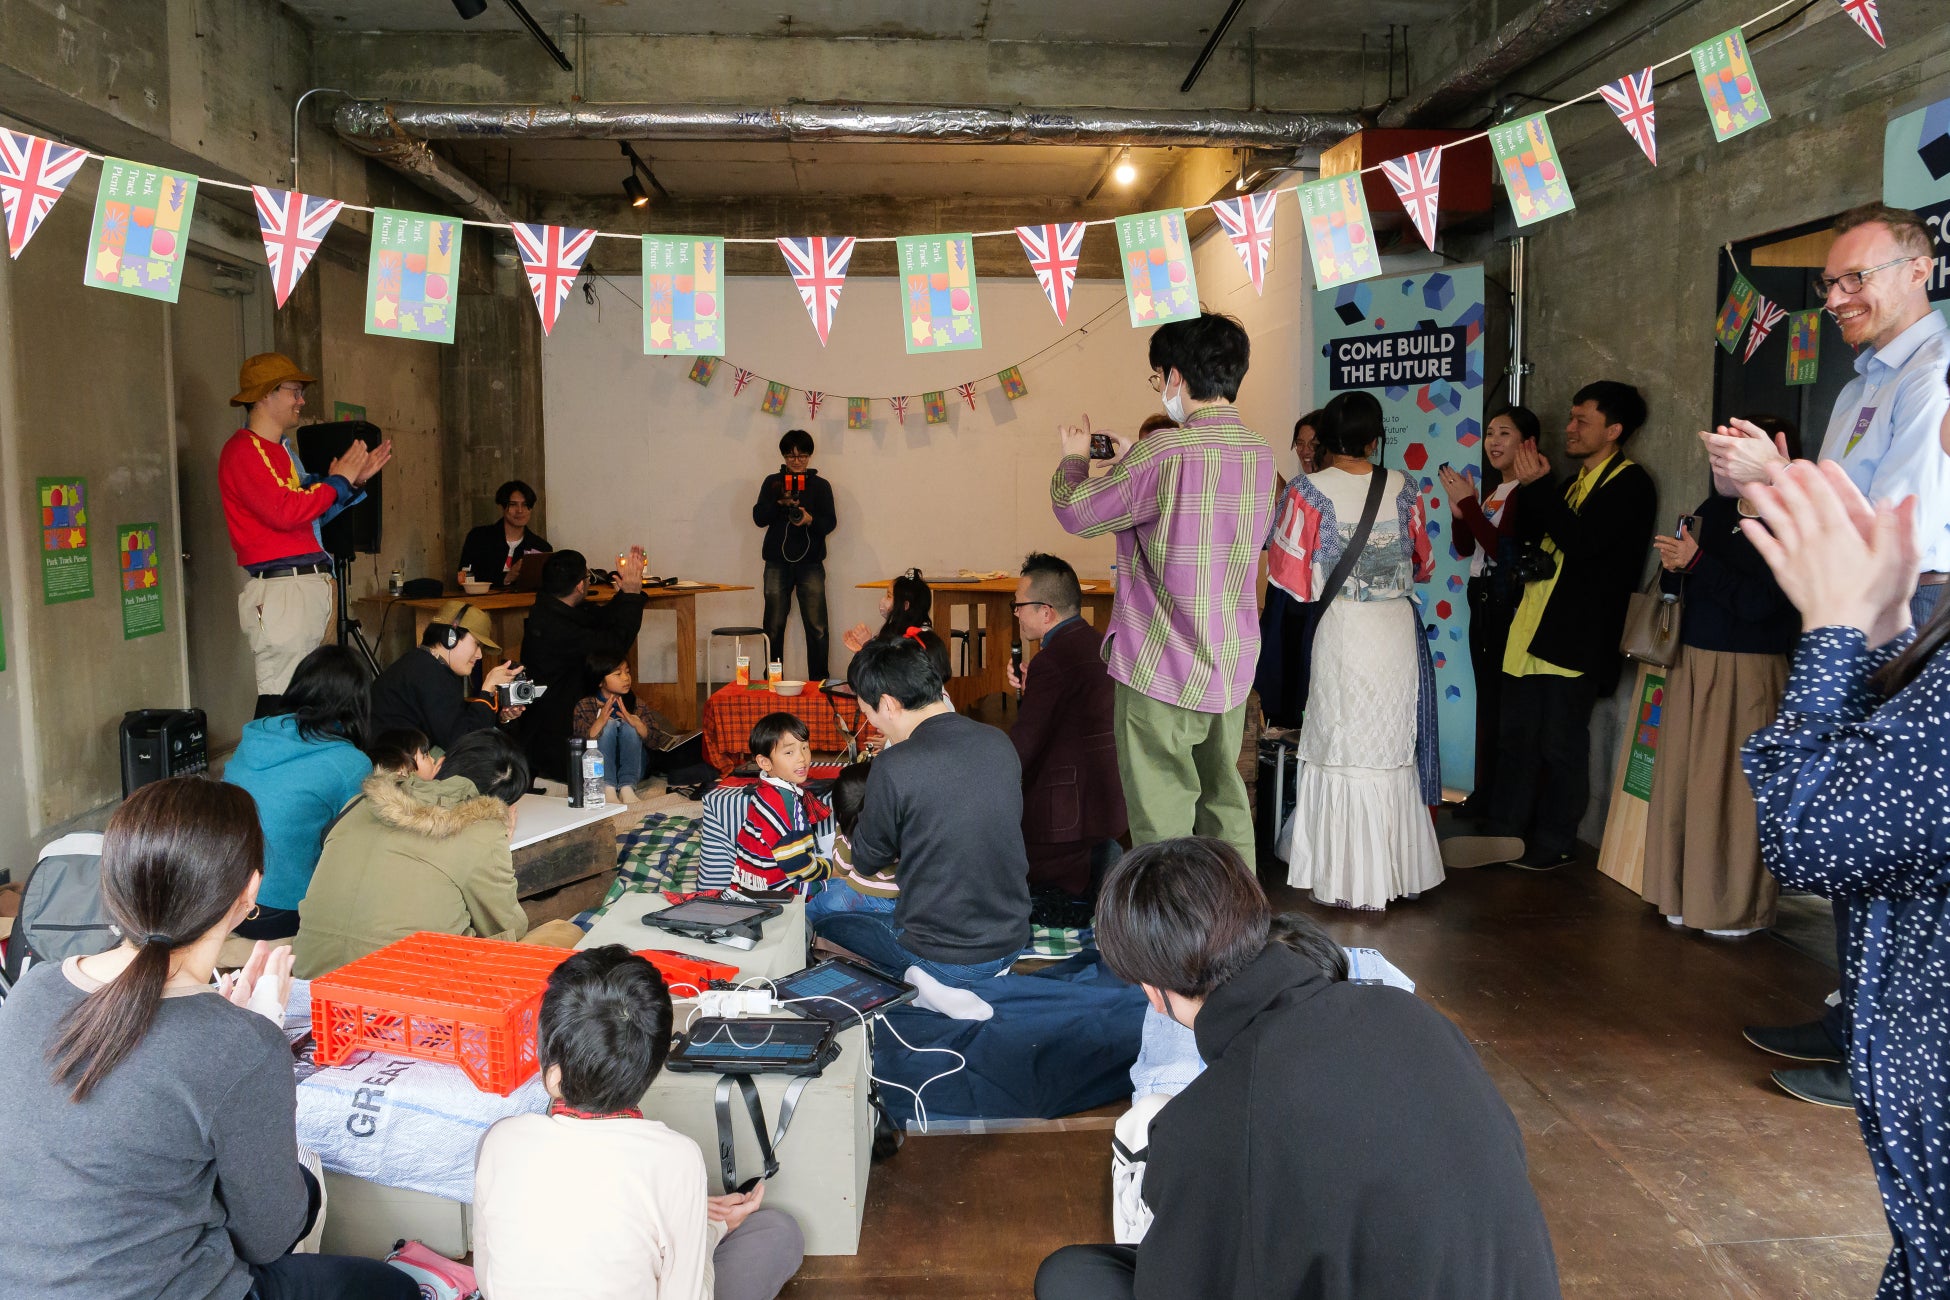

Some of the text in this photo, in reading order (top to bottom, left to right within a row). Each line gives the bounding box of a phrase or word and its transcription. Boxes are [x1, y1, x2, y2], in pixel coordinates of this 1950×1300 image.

[108, 165, 123, 196] Picnic
[125, 169, 140, 197] Track
[143, 172, 157, 196] Park
[381, 216, 393, 245] Picnic
[397, 217, 409, 245] Track
[413, 219, 425, 242] Park
[650, 241, 659, 270] Picnic
[664, 241, 674, 268] Track
[680, 242, 689, 264] Park
[905, 243, 915, 271] Picnic
[919, 242, 929, 268] Track
[933, 242, 942, 263] Park
[1338, 333, 1455, 362] COME BUILD
[1340, 357, 1452, 384] THE FUTURE
[1392, 415, 1400, 423] to
[346, 1060, 417, 1138] GREAT
